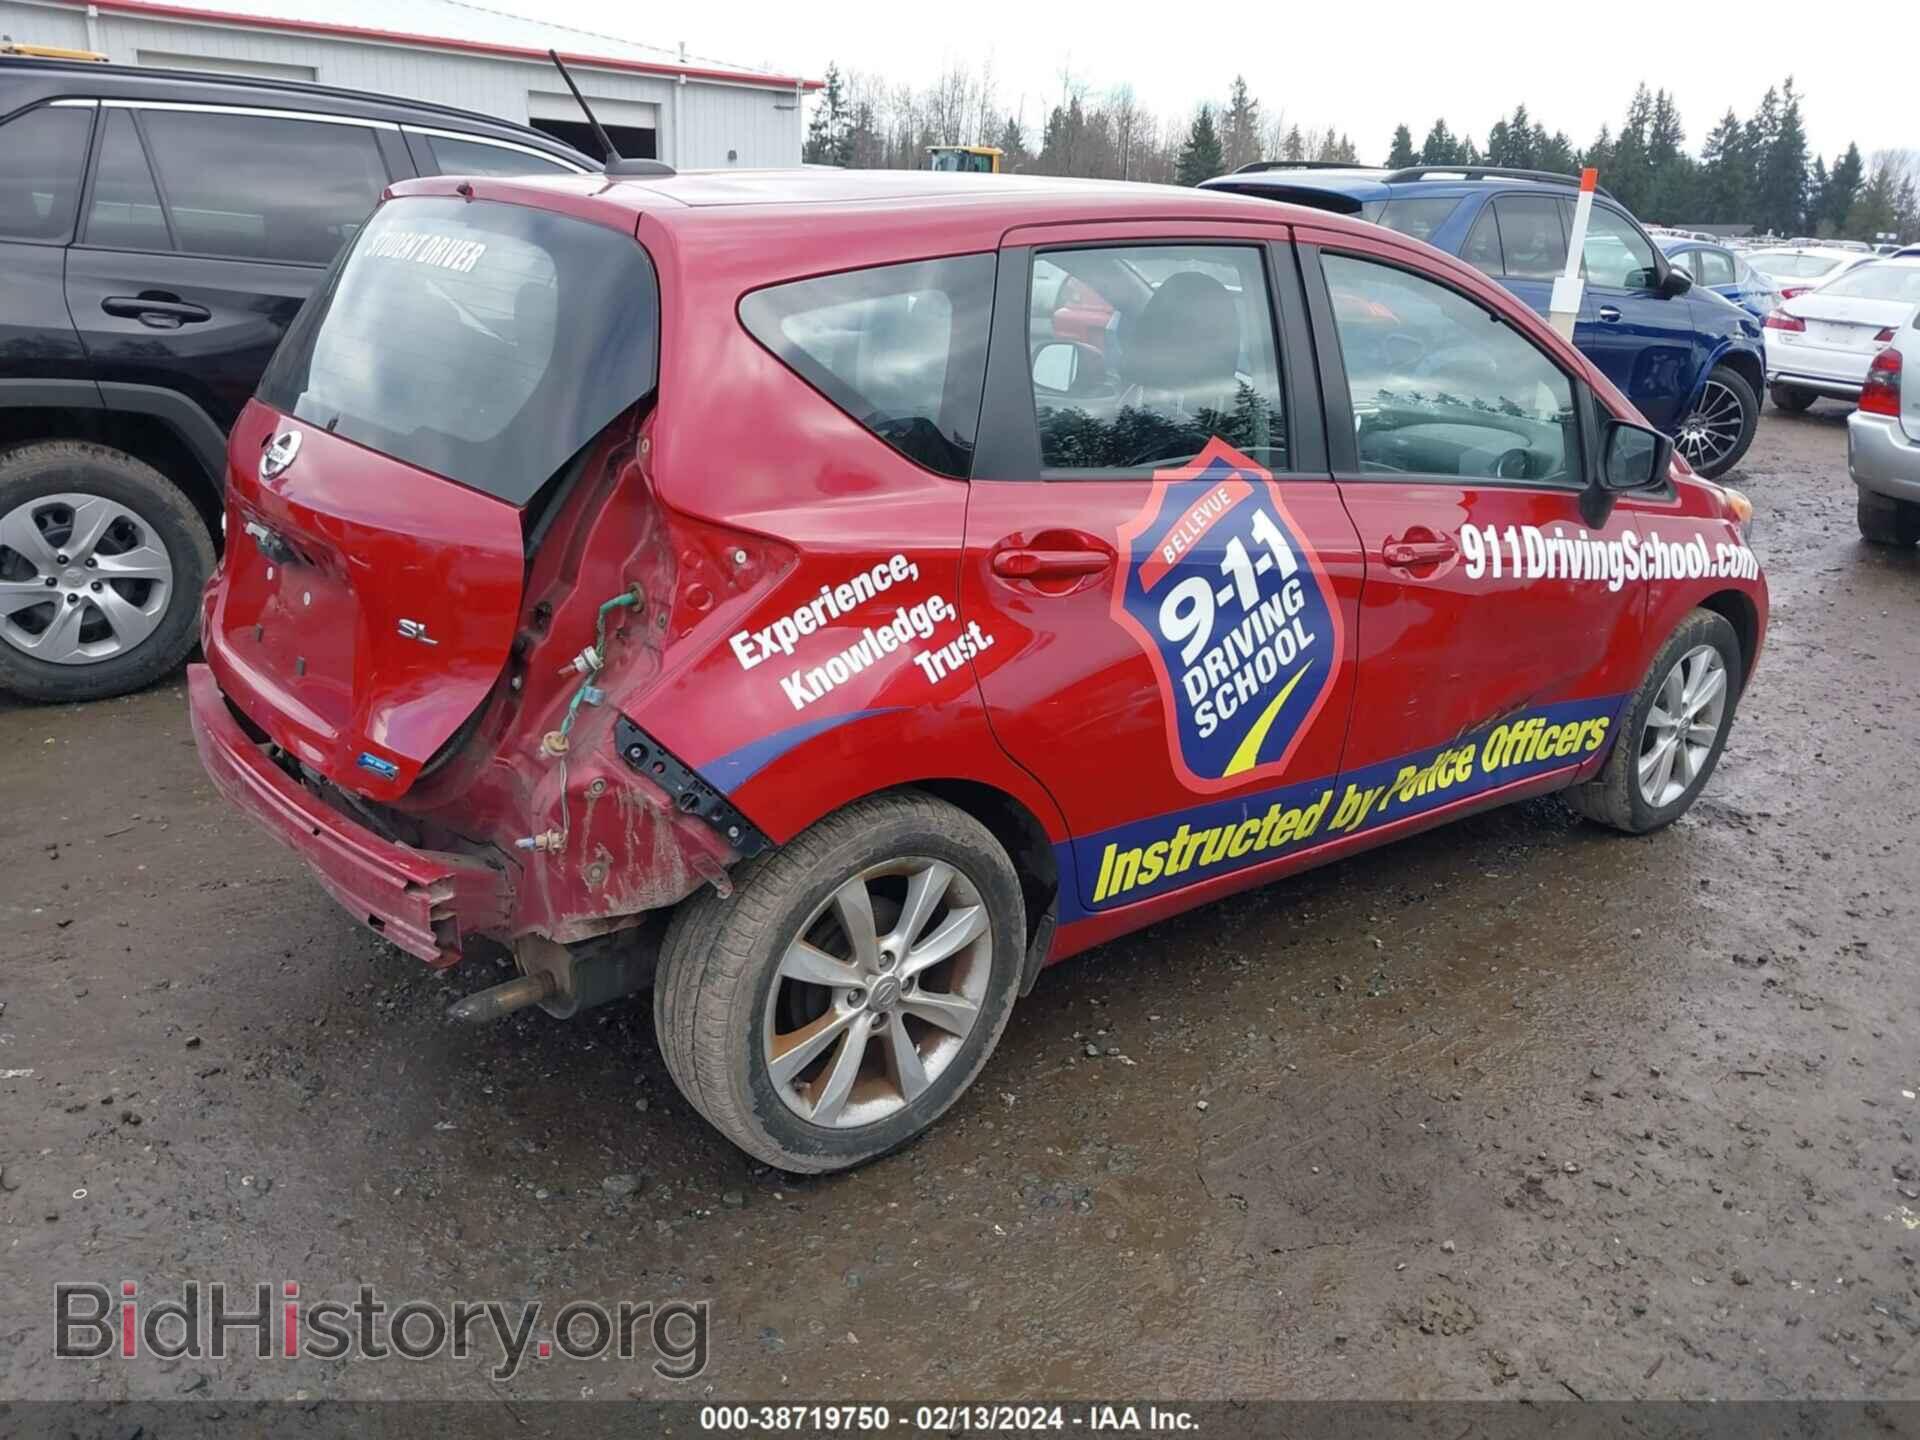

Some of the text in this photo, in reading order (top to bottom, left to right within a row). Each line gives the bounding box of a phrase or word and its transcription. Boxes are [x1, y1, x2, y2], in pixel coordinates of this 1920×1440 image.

[363, 231, 487, 272] STUDENT DRIVER
[1162, 487, 1232, 565] BELLEVUE
[1460, 523, 1759, 592] 911DrivingSchool.com
[398, 618, 439, 644] SL
[728, 552, 919, 671] Experience,
[1158, 508, 1299, 667] 9-1-1
[1181, 578, 1305, 707] DRIVING
[779, 594, 957, 711] Knowledge,
[913, 620, 995, 685] Trust.
[1194, 617, 1316, 738] SCHOOL
[1092, 716, 1610, 903] Instructed by Police Officers
